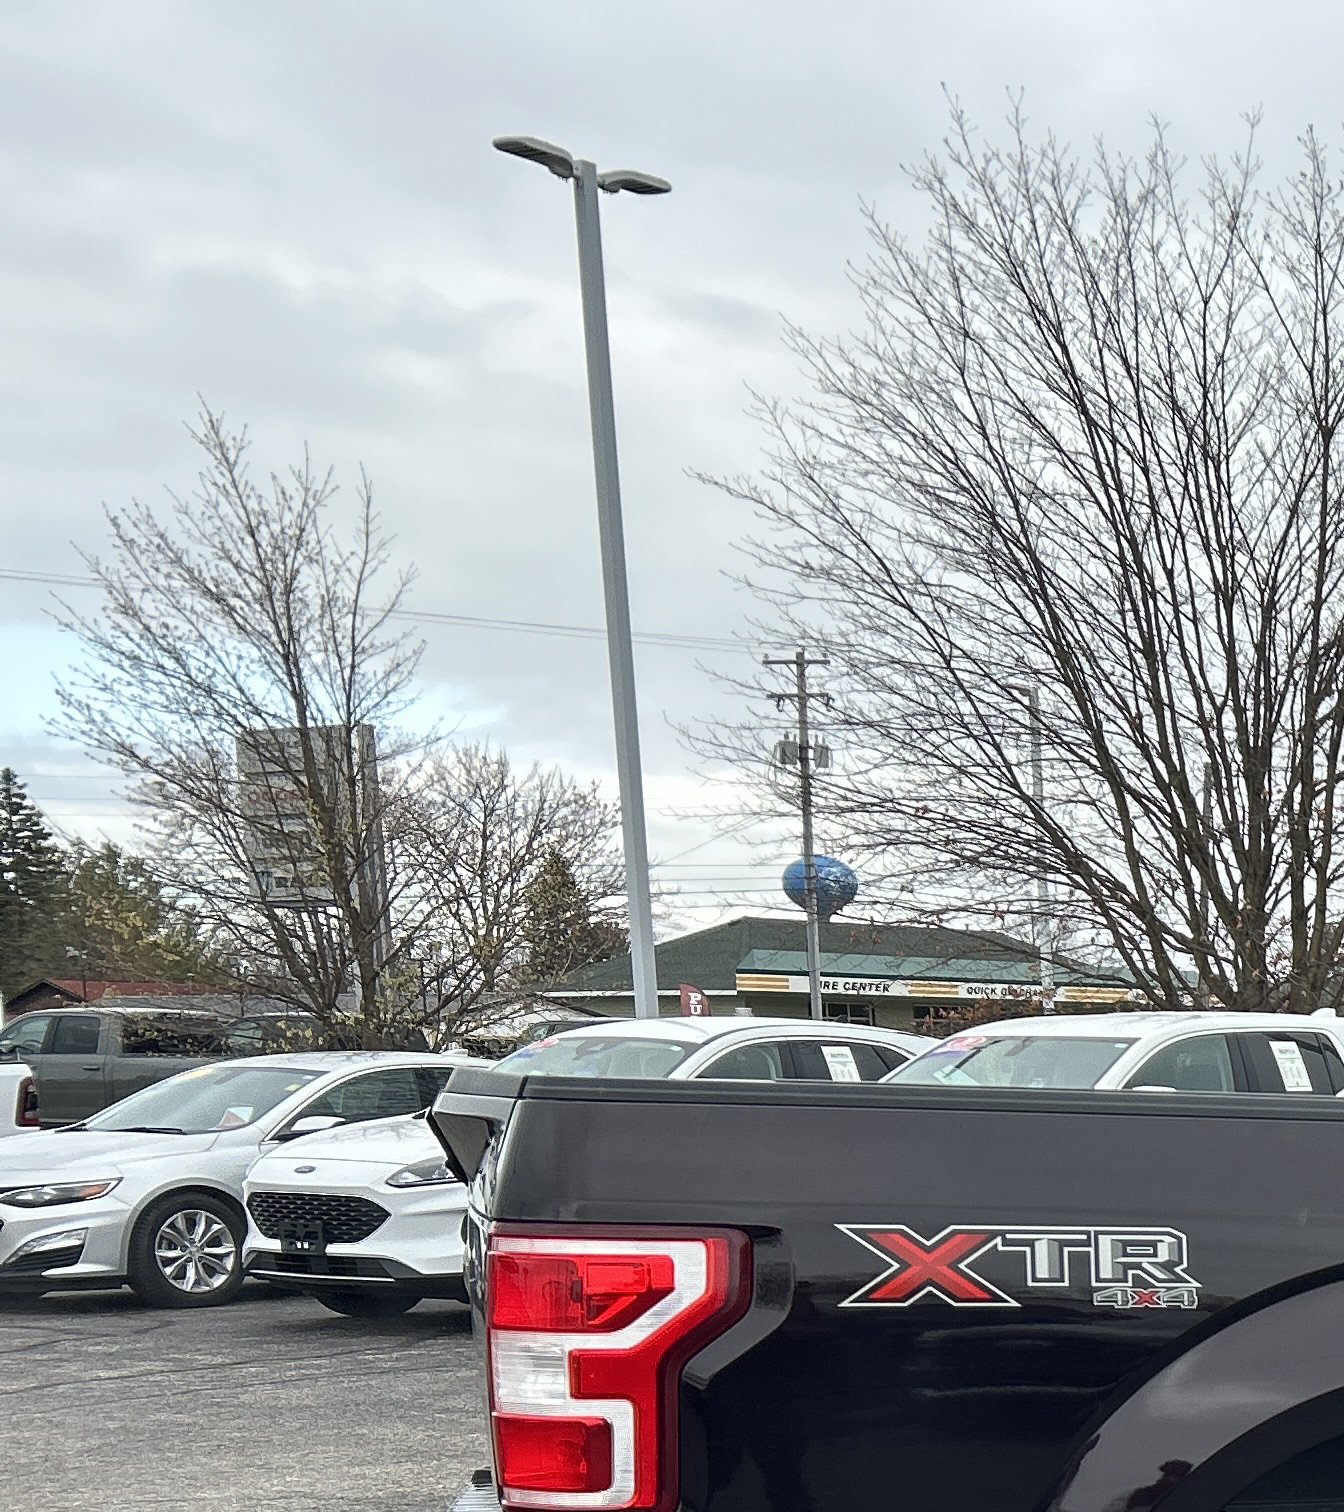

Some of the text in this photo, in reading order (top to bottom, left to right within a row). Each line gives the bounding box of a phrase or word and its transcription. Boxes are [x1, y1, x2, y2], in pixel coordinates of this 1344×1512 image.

[818, 980, 891, 994] IRE CENTER
[966, 986, 997, 996] QUICK
[834, 1223, 1202, 1307] XTR
